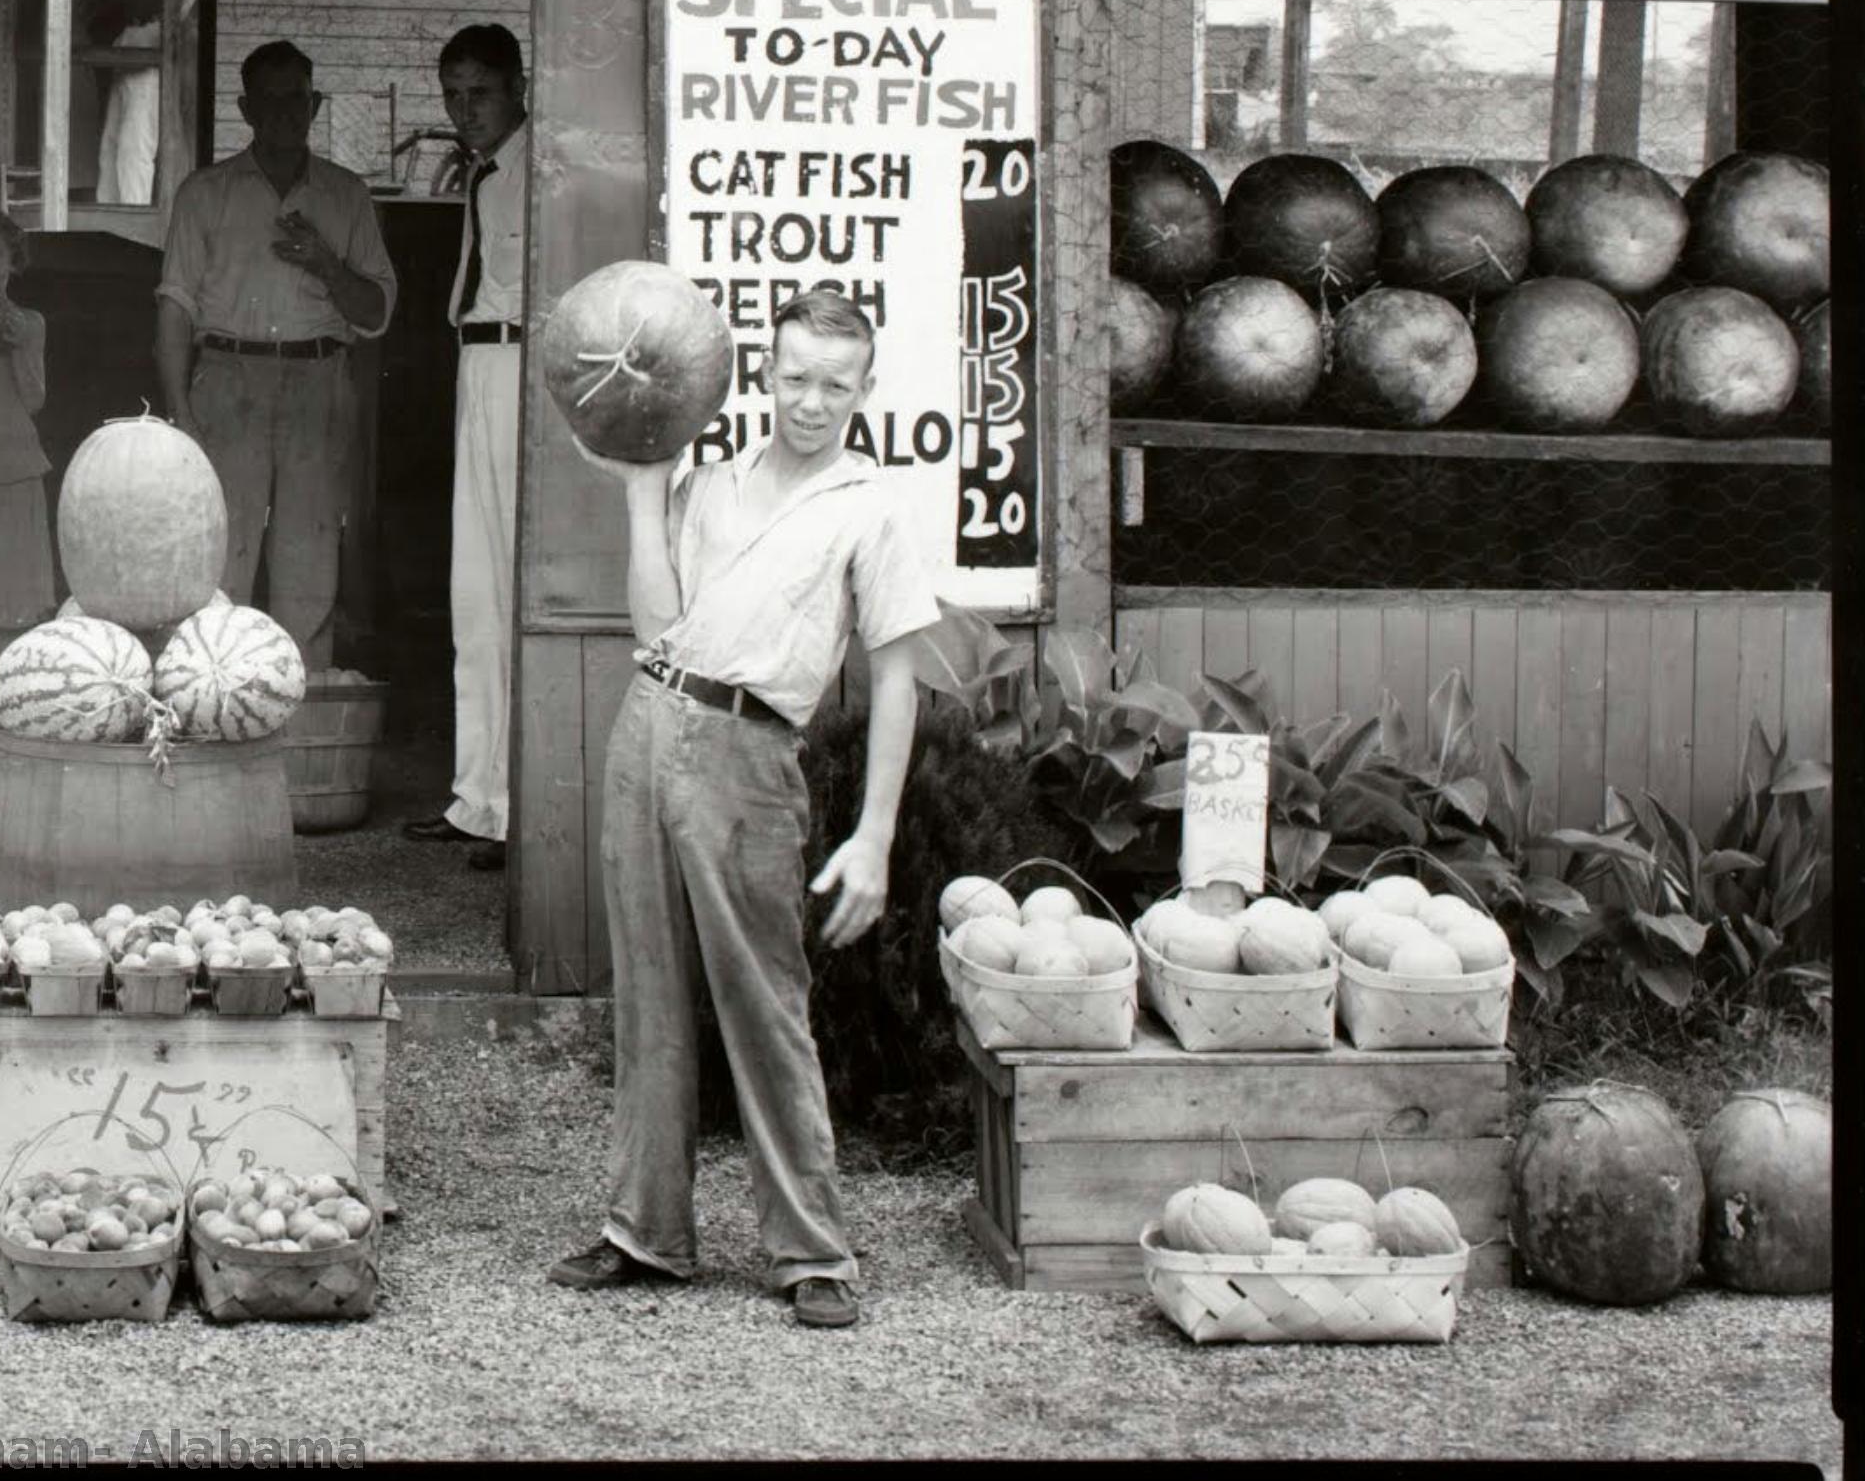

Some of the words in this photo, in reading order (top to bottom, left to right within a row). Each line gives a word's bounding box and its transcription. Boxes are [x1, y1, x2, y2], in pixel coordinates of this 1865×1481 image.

[681, 74, 859, 125] RIVER
[878, 78, 1016, 131] FISH
[961, 149, 1029, 200] 20
[689, 212, 899, 264] TROUT
[961, 267, 1029, 354] 15
[962, 348, 1028, 418] 15
[693, 410, 952, 467] BUALO
[961, 419, 1016, 480] 15
[961, 488, 1026, 538] 20
